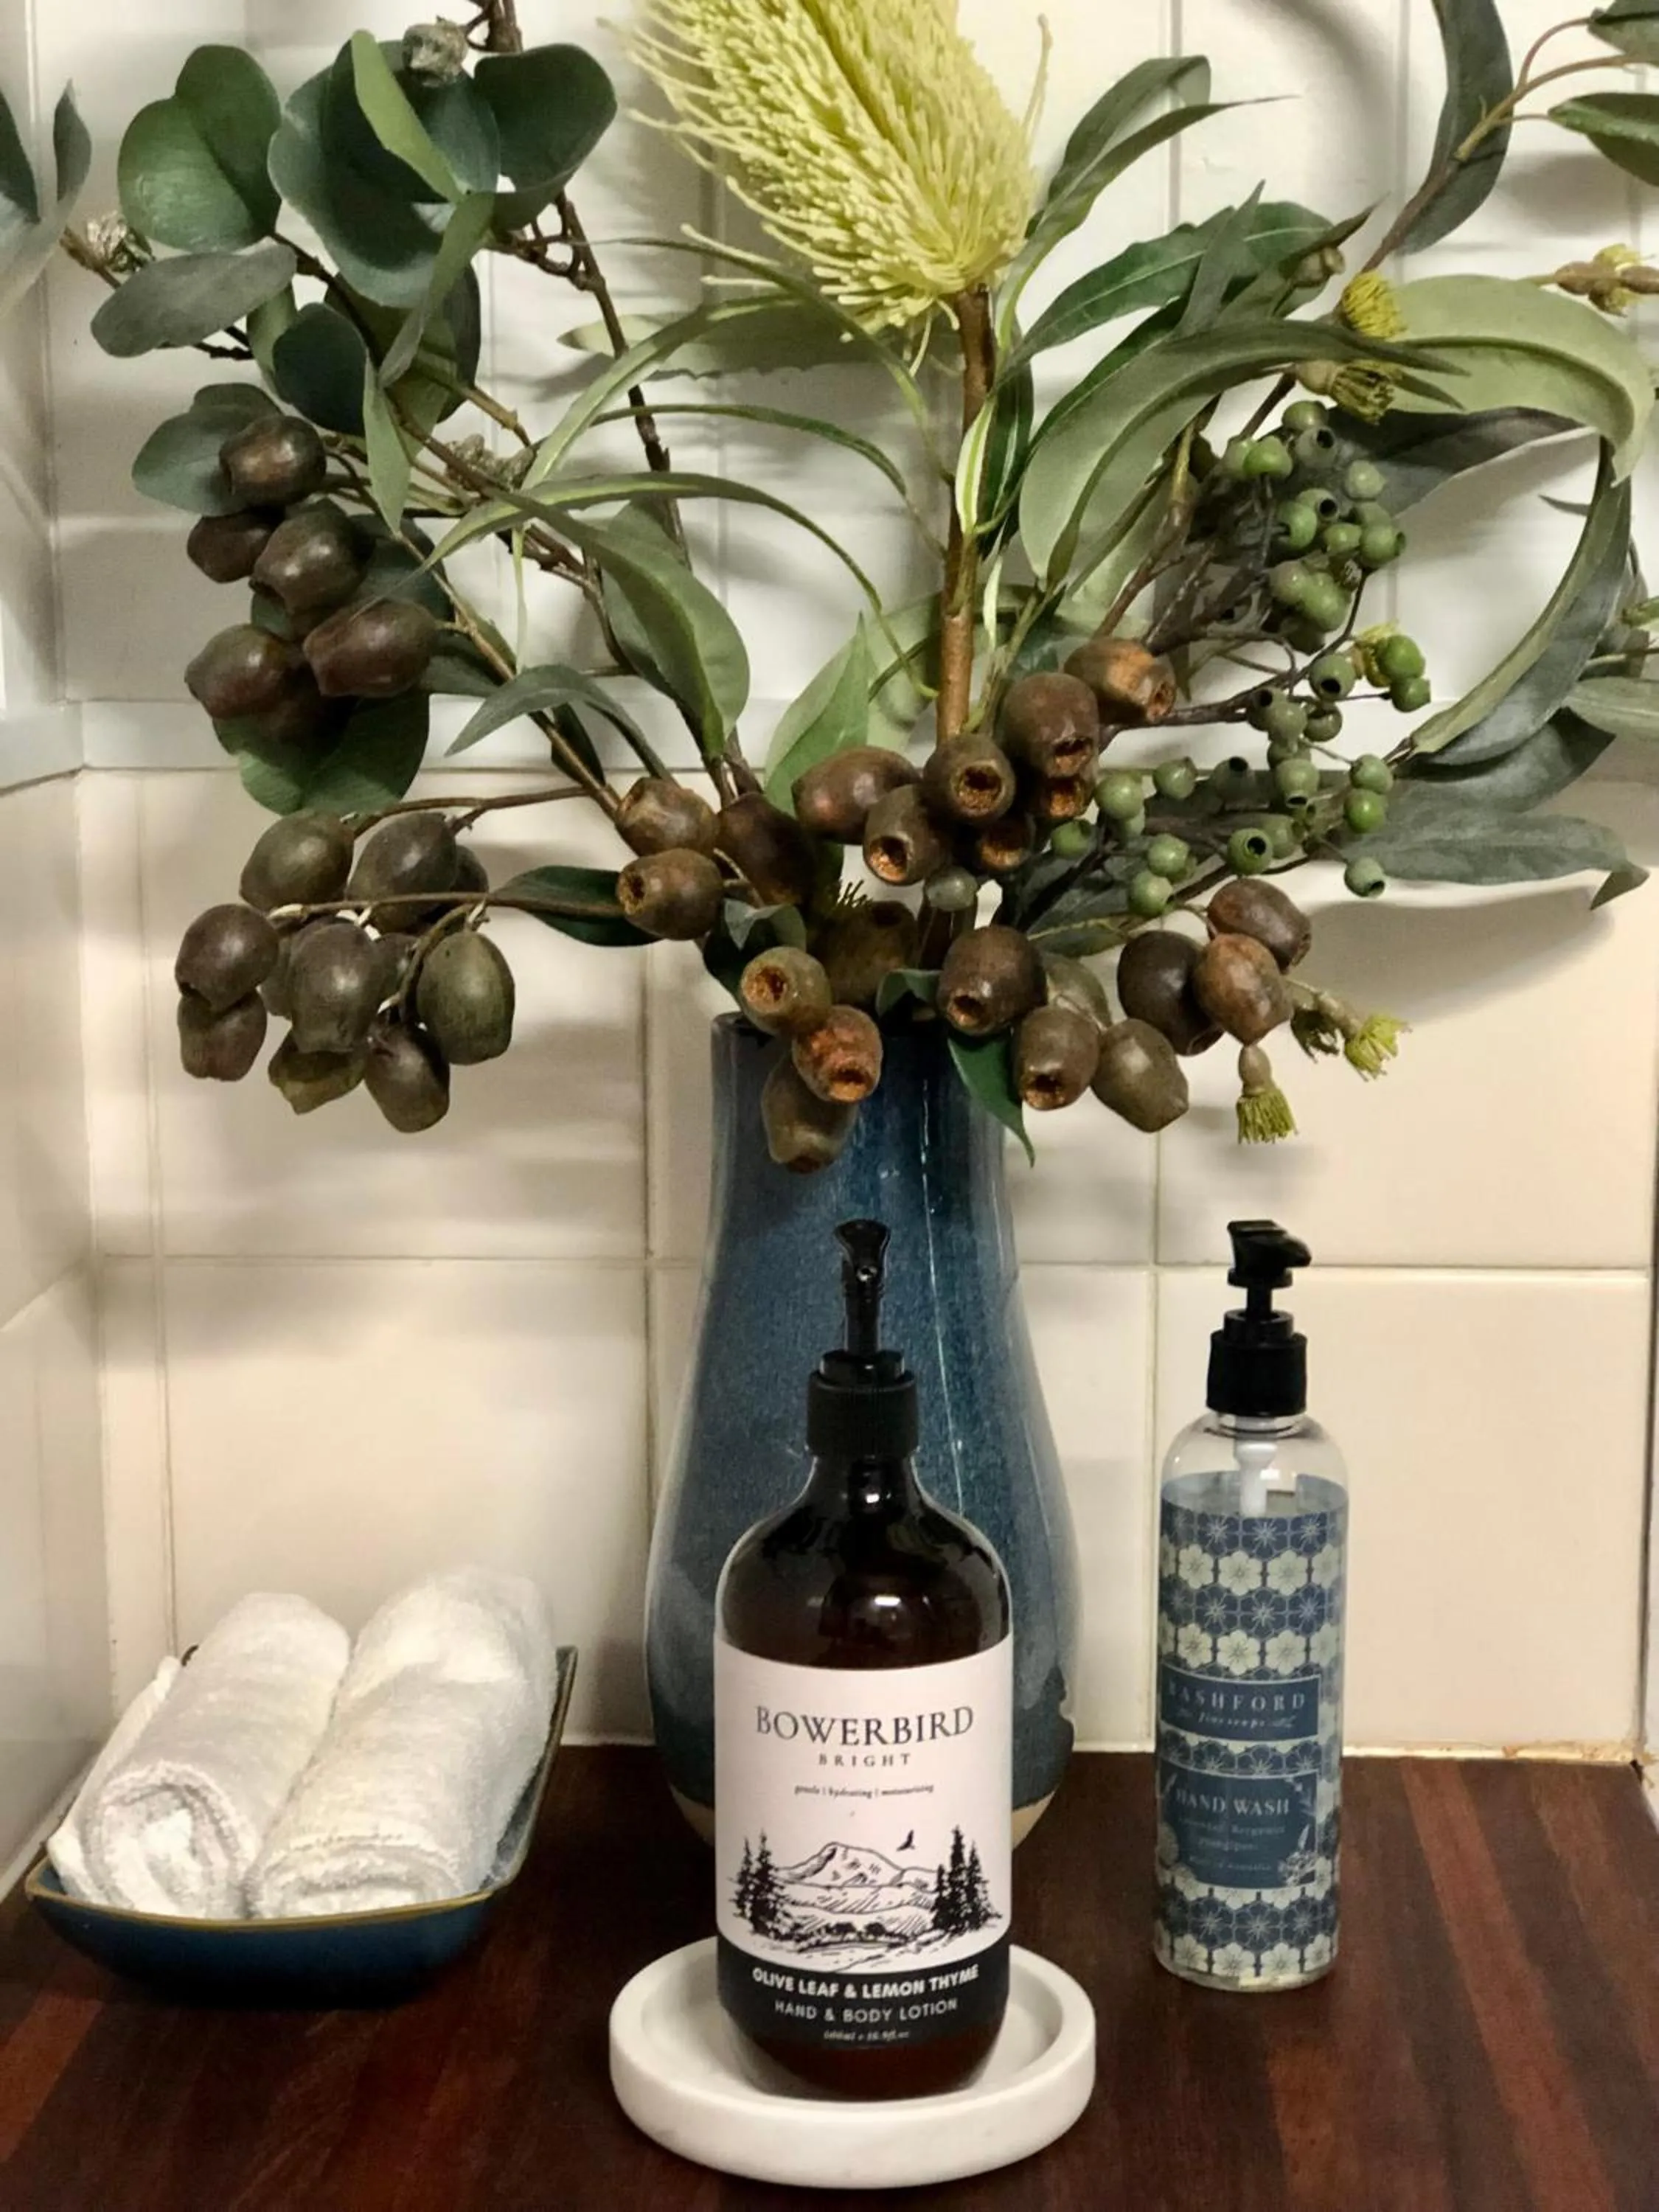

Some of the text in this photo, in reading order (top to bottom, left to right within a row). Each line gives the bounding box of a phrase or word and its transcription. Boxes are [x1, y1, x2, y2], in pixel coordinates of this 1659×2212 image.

[755, 1705, 973, 1746] BOWERBIRD
[818, 1753, 911, 1767] BRIGHT
[1177, 1789, 1289, 1815] HAND WASH
[752, 1964, 978, 1999] OLIVE LEAF & LEMON THYME
[775, 1998, 958, 2023] HAND & BODY LOTION
